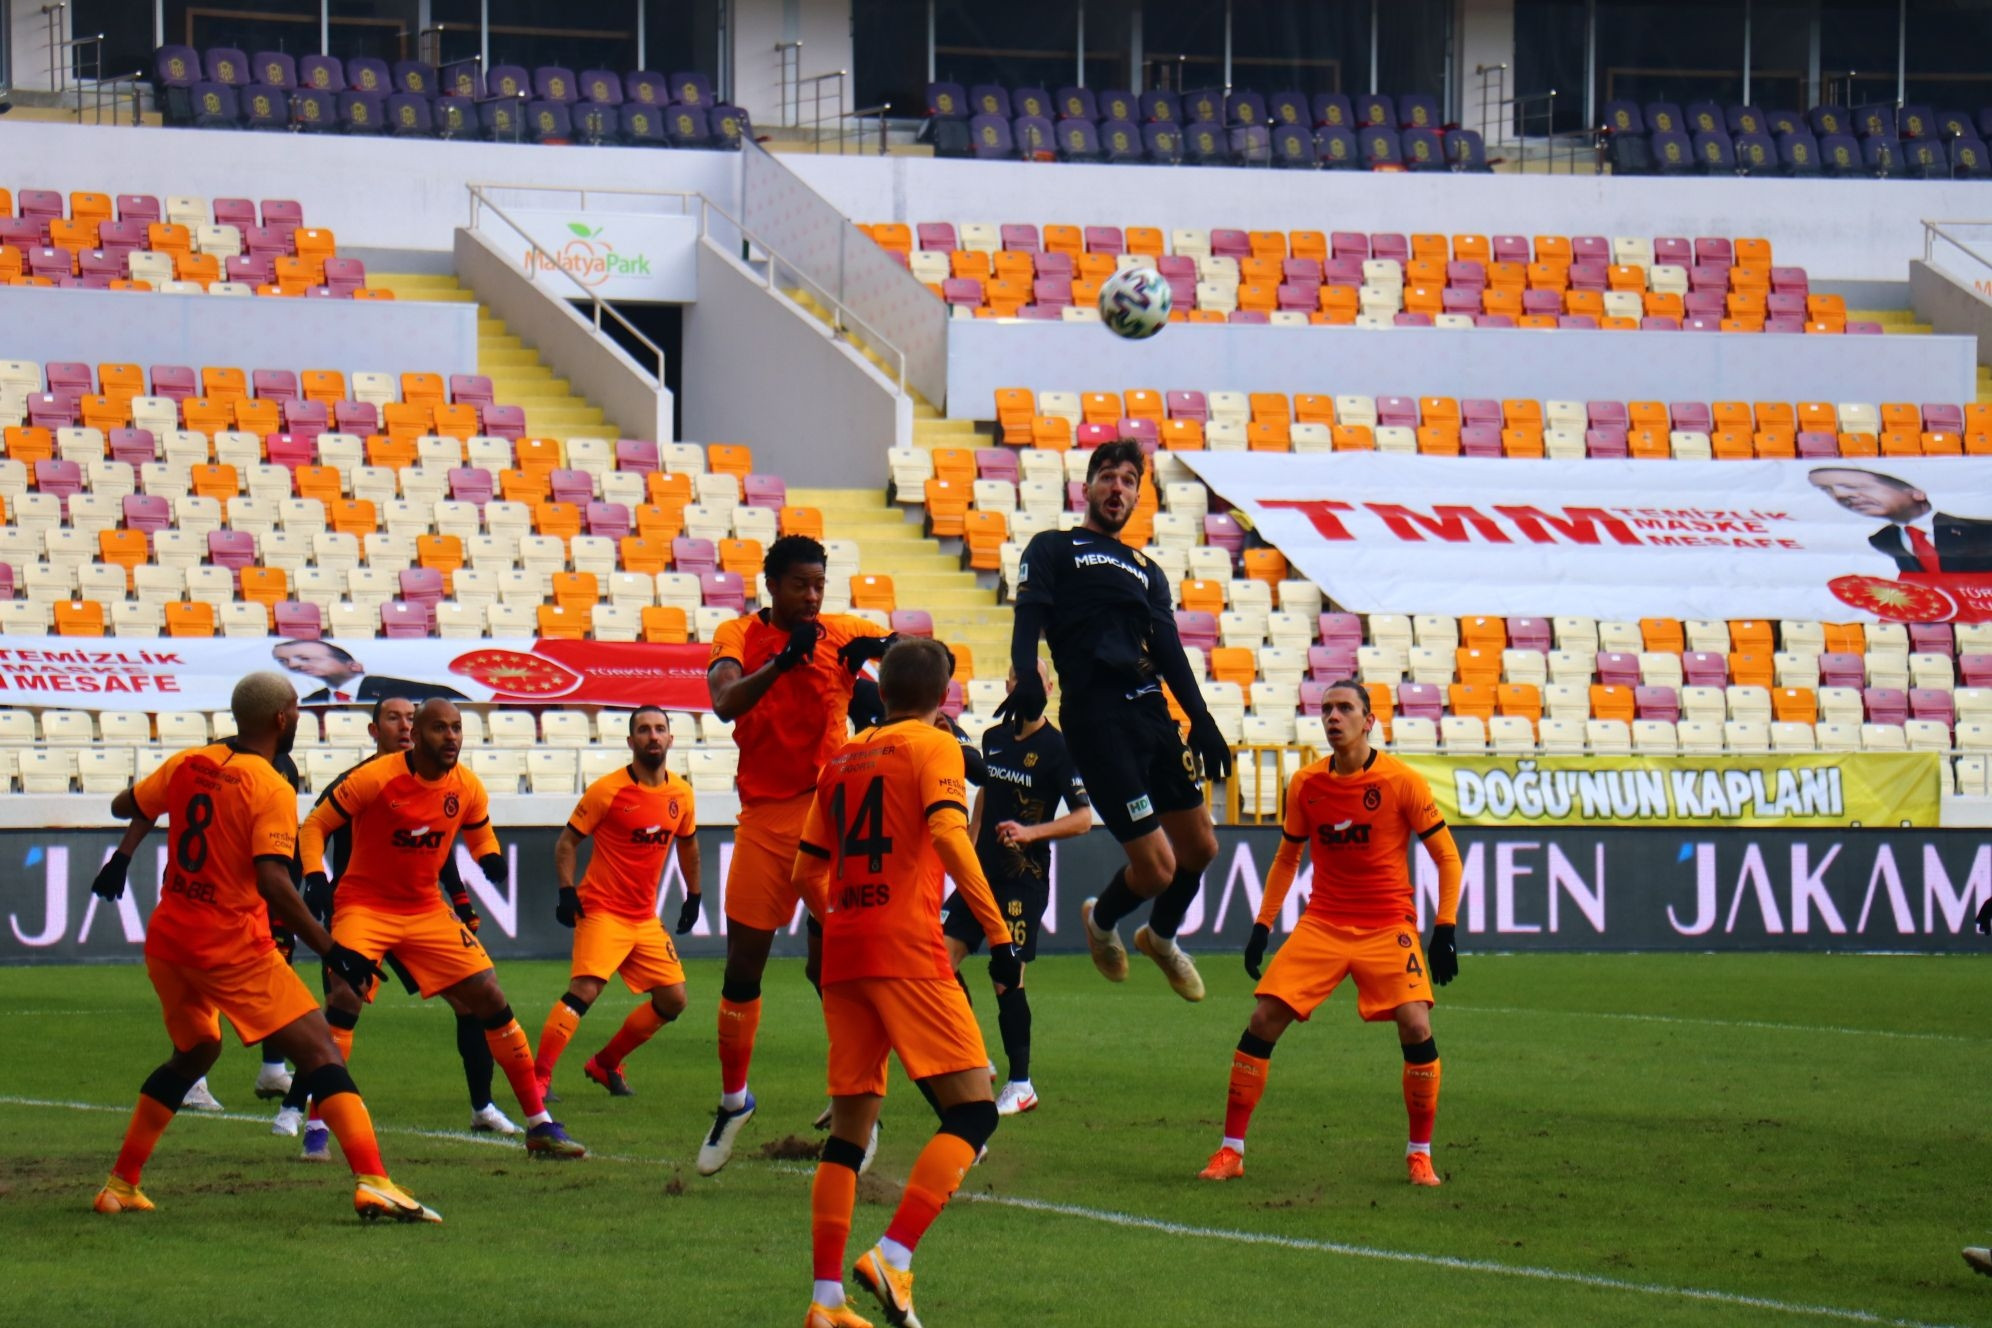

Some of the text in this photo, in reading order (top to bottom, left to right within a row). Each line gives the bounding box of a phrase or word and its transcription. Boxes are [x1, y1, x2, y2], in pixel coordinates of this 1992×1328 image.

[1254, 499, 1643, 546] TMM
[1632, 518, 1769, 533] MASKE
[1646, 534, 1805, 550] MESAFE
[15, 674, 182, 694] MESAFE
[1454, 760, 1844, 820] DOĞU'NUN KAPLANI
[176, 792, 214, 874] 8
[831, 775, 893, 881] 14
[1405, 952, 1423, 978] 4
